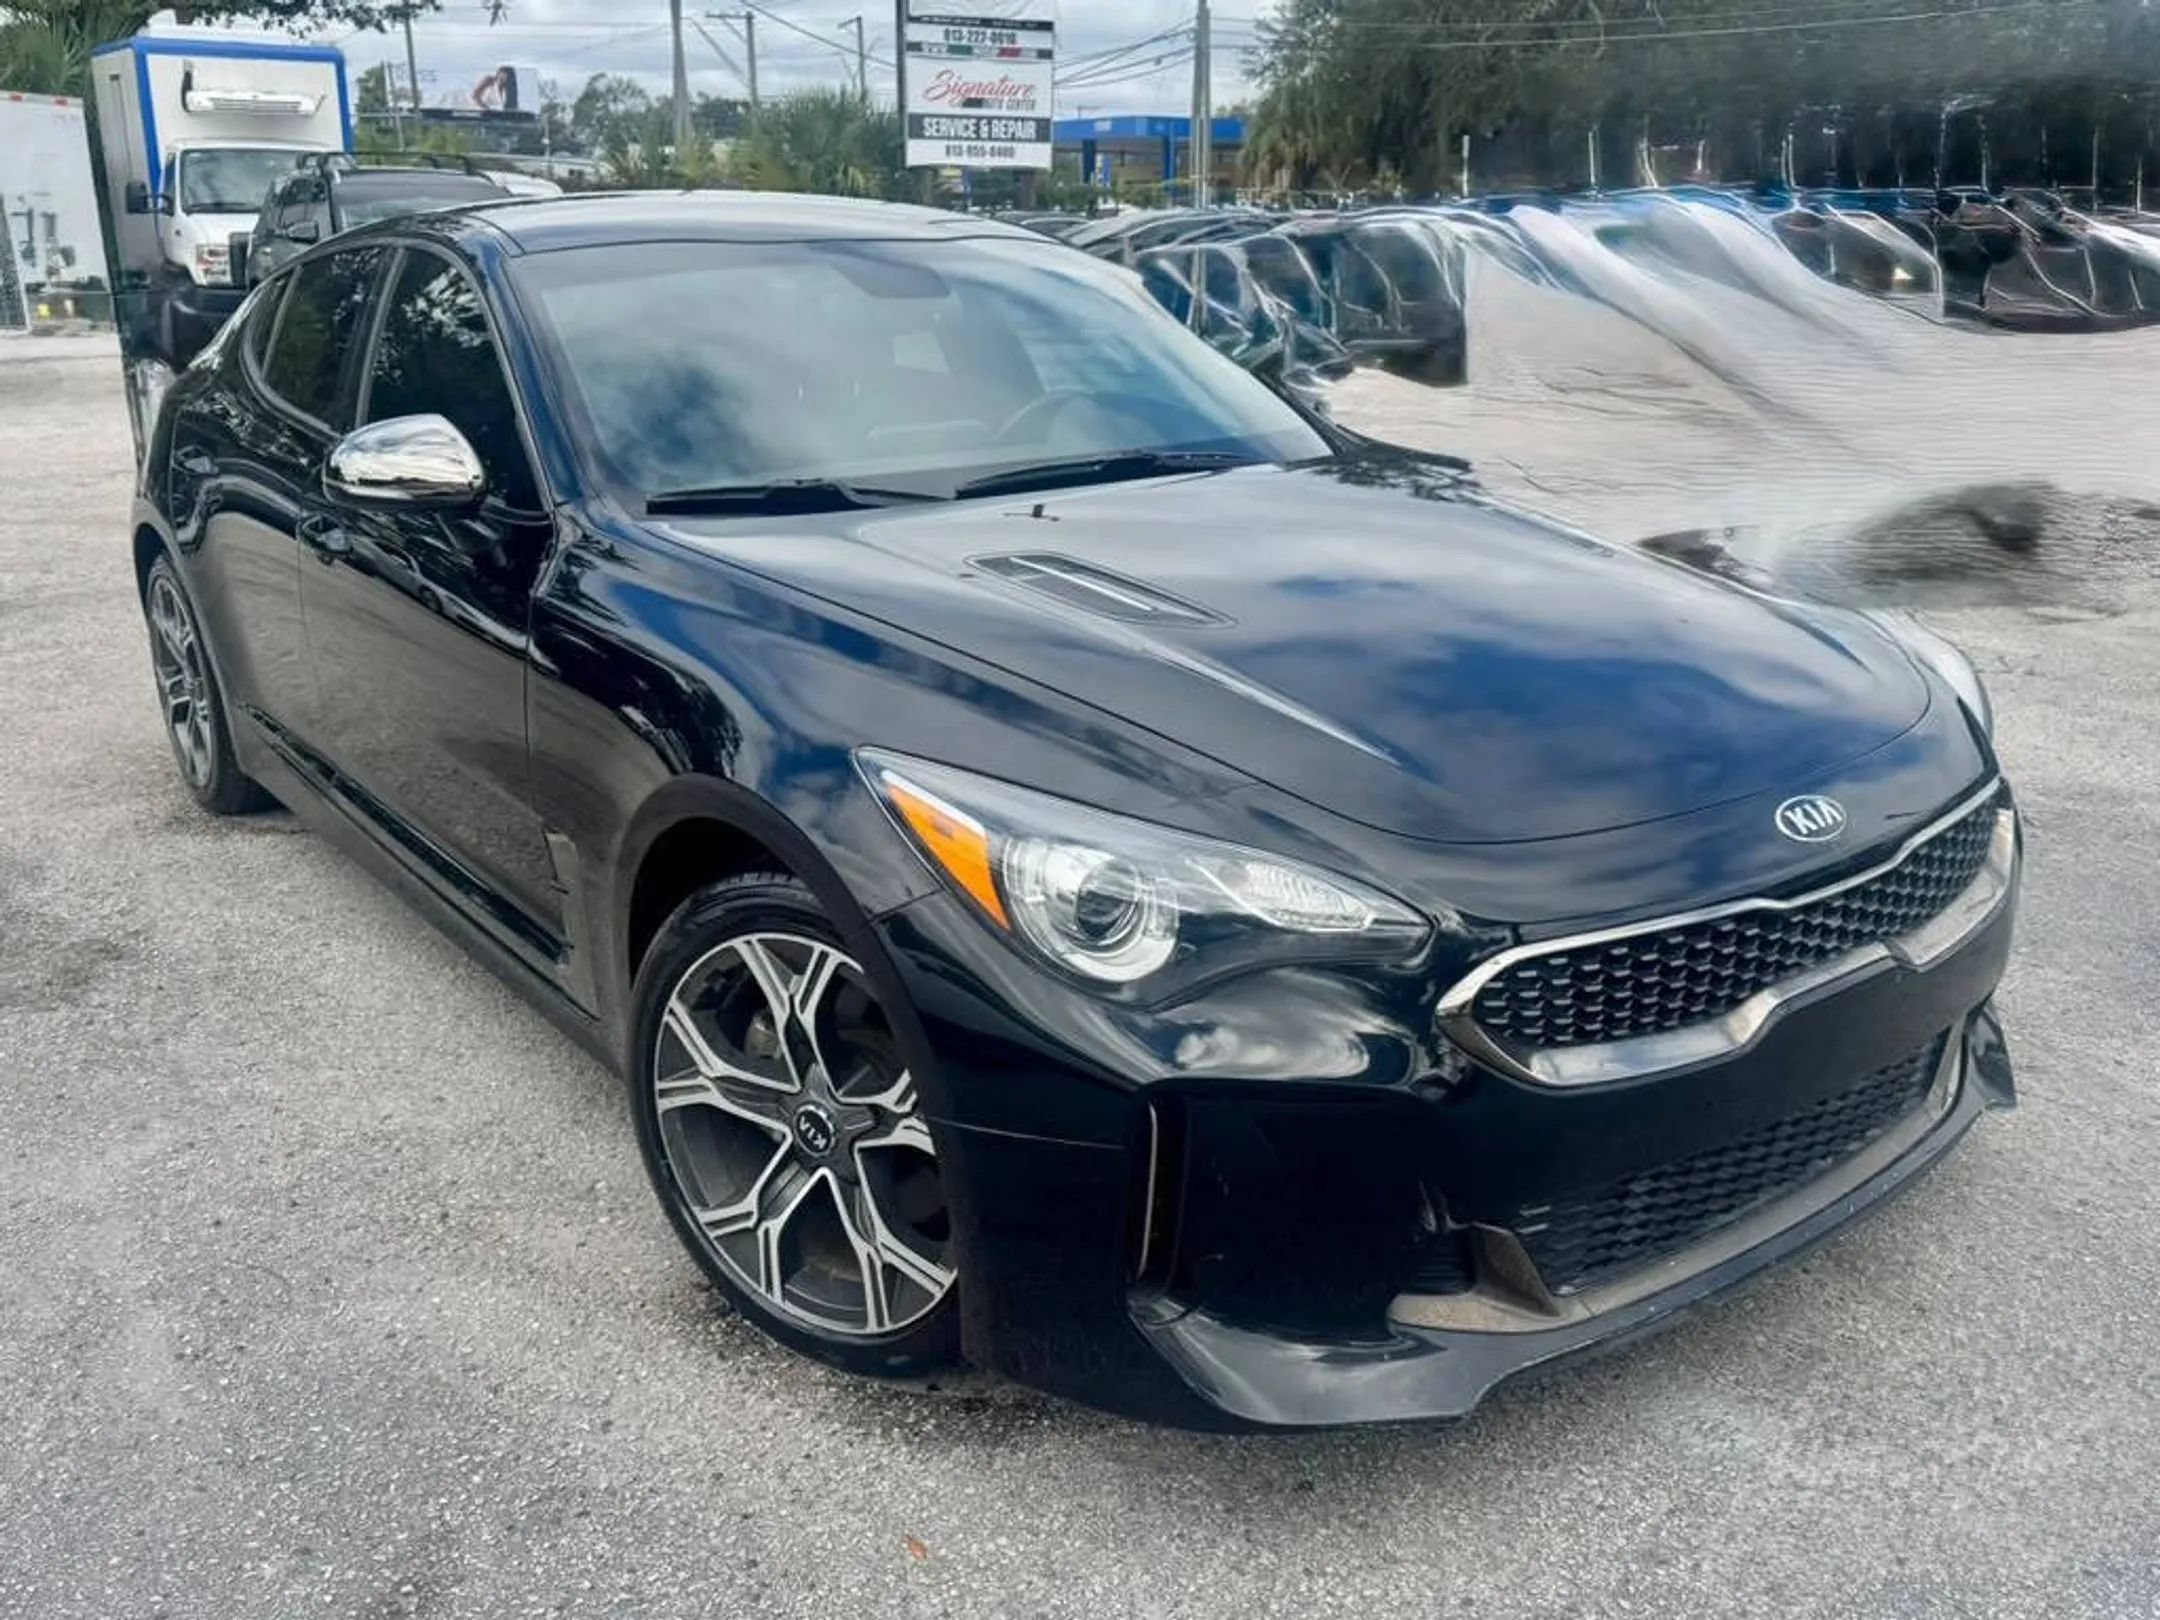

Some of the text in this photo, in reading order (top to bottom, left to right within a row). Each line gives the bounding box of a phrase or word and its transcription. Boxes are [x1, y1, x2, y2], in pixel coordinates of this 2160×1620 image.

[924, 69, 1036, 109] Signature
[923, 117, 1037, 140] SERVICE & REPAIR
[1783, 800, 1844, 835] KIA
[799, 1115, 828, 1150] KIA
